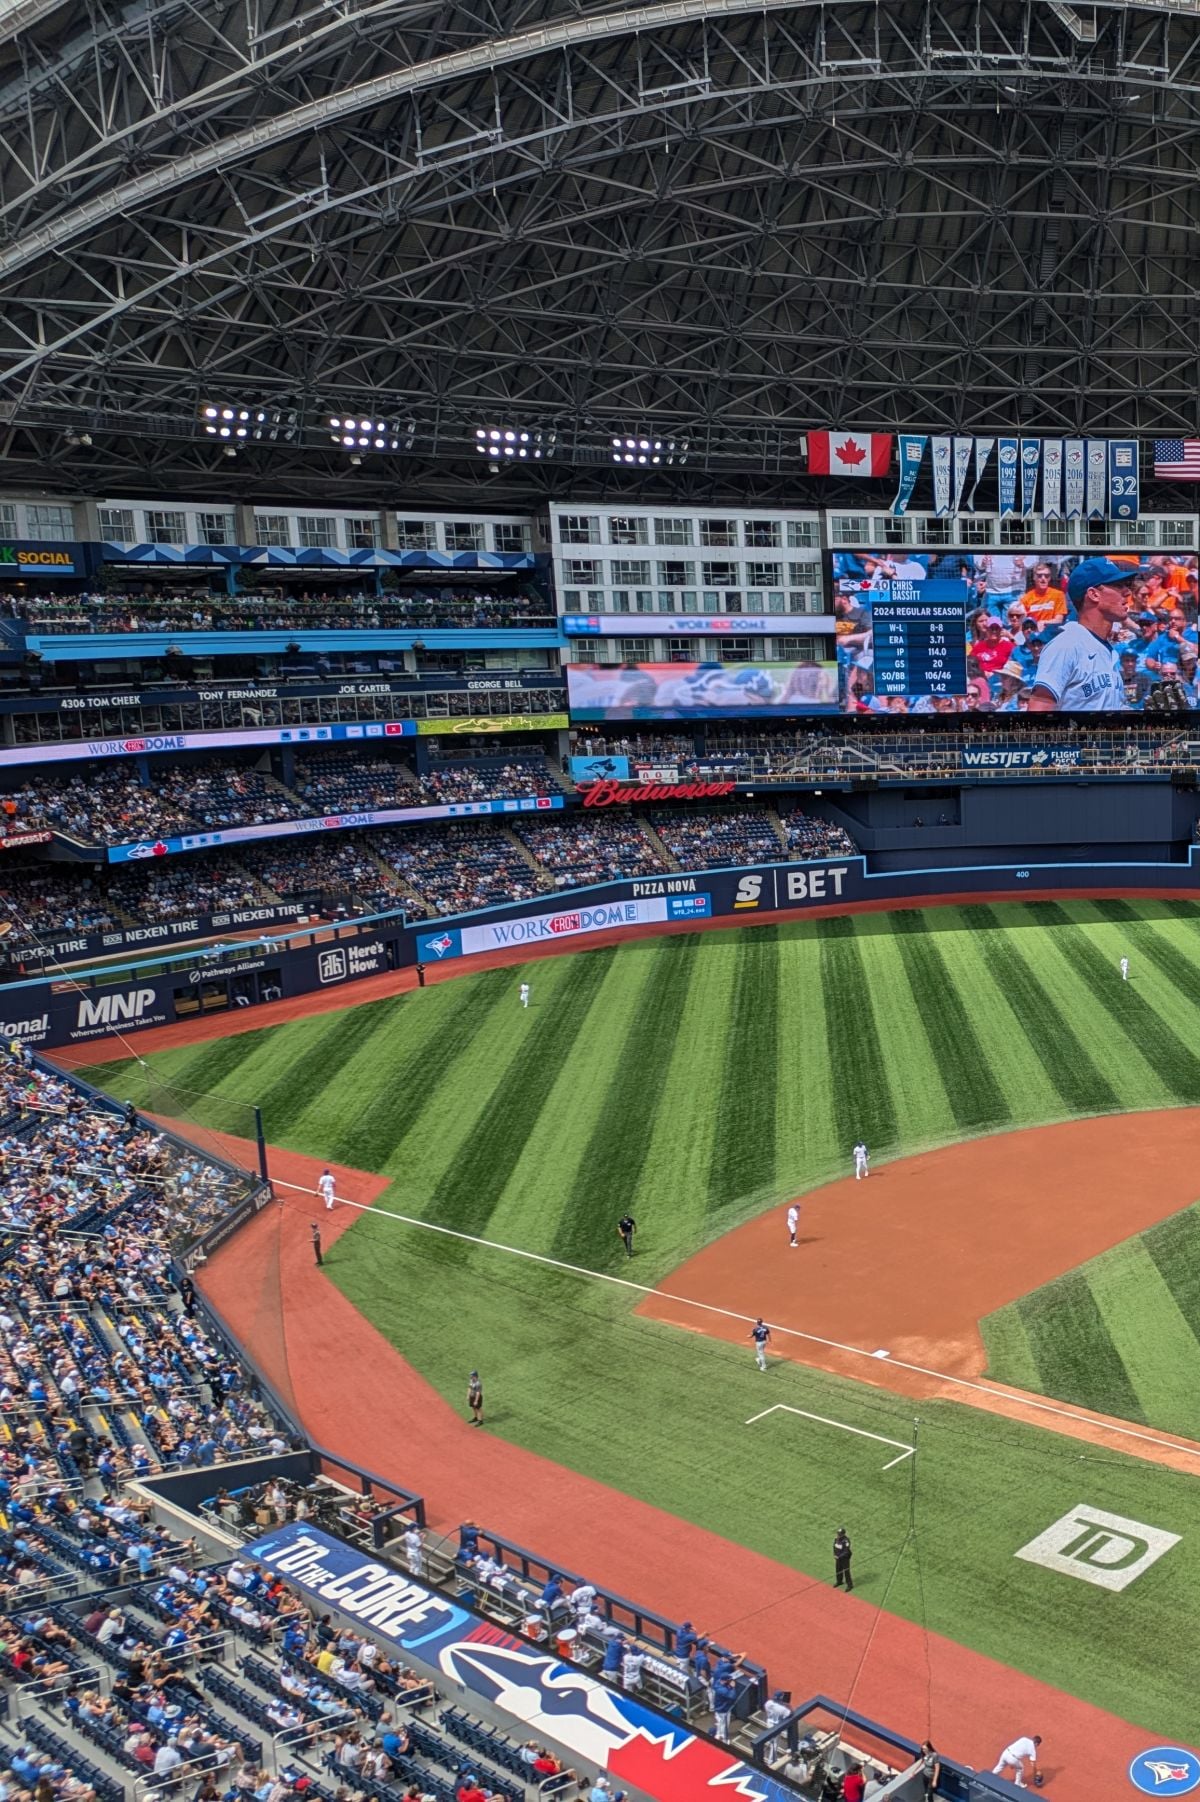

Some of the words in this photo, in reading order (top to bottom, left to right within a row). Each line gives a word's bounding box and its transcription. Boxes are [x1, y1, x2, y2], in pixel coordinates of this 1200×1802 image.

[1001, 468, 1016, 478] 1992
[1024, 468, 1037, 479] 1993
[1045, 469, 1060, 479] 2015
[1067, 469, 1082, 479] 2016
[1112, 476, 1137, 495] 32
[17, 552, 74, 564] SOCIAL
[892, 581, 913, 590] CHRIS
[892, 591, 920, 600] BASSITT
[889, 636, 904, 644] ERA
[897, 648, 904, 656] IP
[928, 648, 946, 656] 114.0
[895, 660, 905, 668] GS
[933, 660, 943, 668] 20
[882, 672, 905, 680] SO/BB
[925, 671, 951, 680] 106/46
[338, 685, 356, 694] JOE
[359, 684, 390, 693] CARTER
[468, 680, 501, 689] GEORGE
[505, 680, 522, 688] BELL
[887, 684, 906, 692] WHIP
[931, 684, 946, 692] 1.42
[1082, 674, 1112, 698] BLUE
[61, 699, 85, 709] 4306
[87, 697, 110, 707] TOM
[111, 696, 141, 706] CHEEK
[198, 691, 224, 700] TONY
[227, 689, 278, 699] FERNANDEZ
[88, 741, 126, 755] WORK
[145, 736, 184, 750] DOME
[964, 751, 1031, 768] WESTJET
[575, 779, 737, 808] Budweiser
[294, 819, 325, 831] WORK
[341, 814, 374, 824] DOME
[633, 882, 665, 896] PIZZA
[667, 879, 696, 893] NOVA
[735, 875, 763, 902] S
[787, 867, 848, 900] BET
[233, 908, 274, 924] NEXEN
[277, 903, 305, 917] TIRE
[125, 925, 168, 942] NEXEN
[171, 920, 199, 934] TIRE
[492, 919, 552, 945] WORK
[554, 914, 580, 932] FROM
[580, 904, 638, 928] DOME
[10, 945, 55, 963] NEXEN
[56, 939, 88, 954] TIRE
[349, 941, 384, 962] Here's
[202, 966, 236, 978] Pathways
[237, 961, 265, 971] Alliance
[350, 957, 379, 974] How.
[77, 988, 156, 1028] MNP
[70, 1027, 105, 1039] Wherever
[106, 1021, 135, 1032] Business
[135, 1018, 152, 1027] Takes
[153, 1014, 166, 1022] You
[255, 1186, 272, 1210] VISA
[1058, 1517, 1149, 1571] TD
[263, 1536, 330, 1573] TO
[291, 1562, 337, 1588] THE
[318, 1563, 452, 1637] CORE
